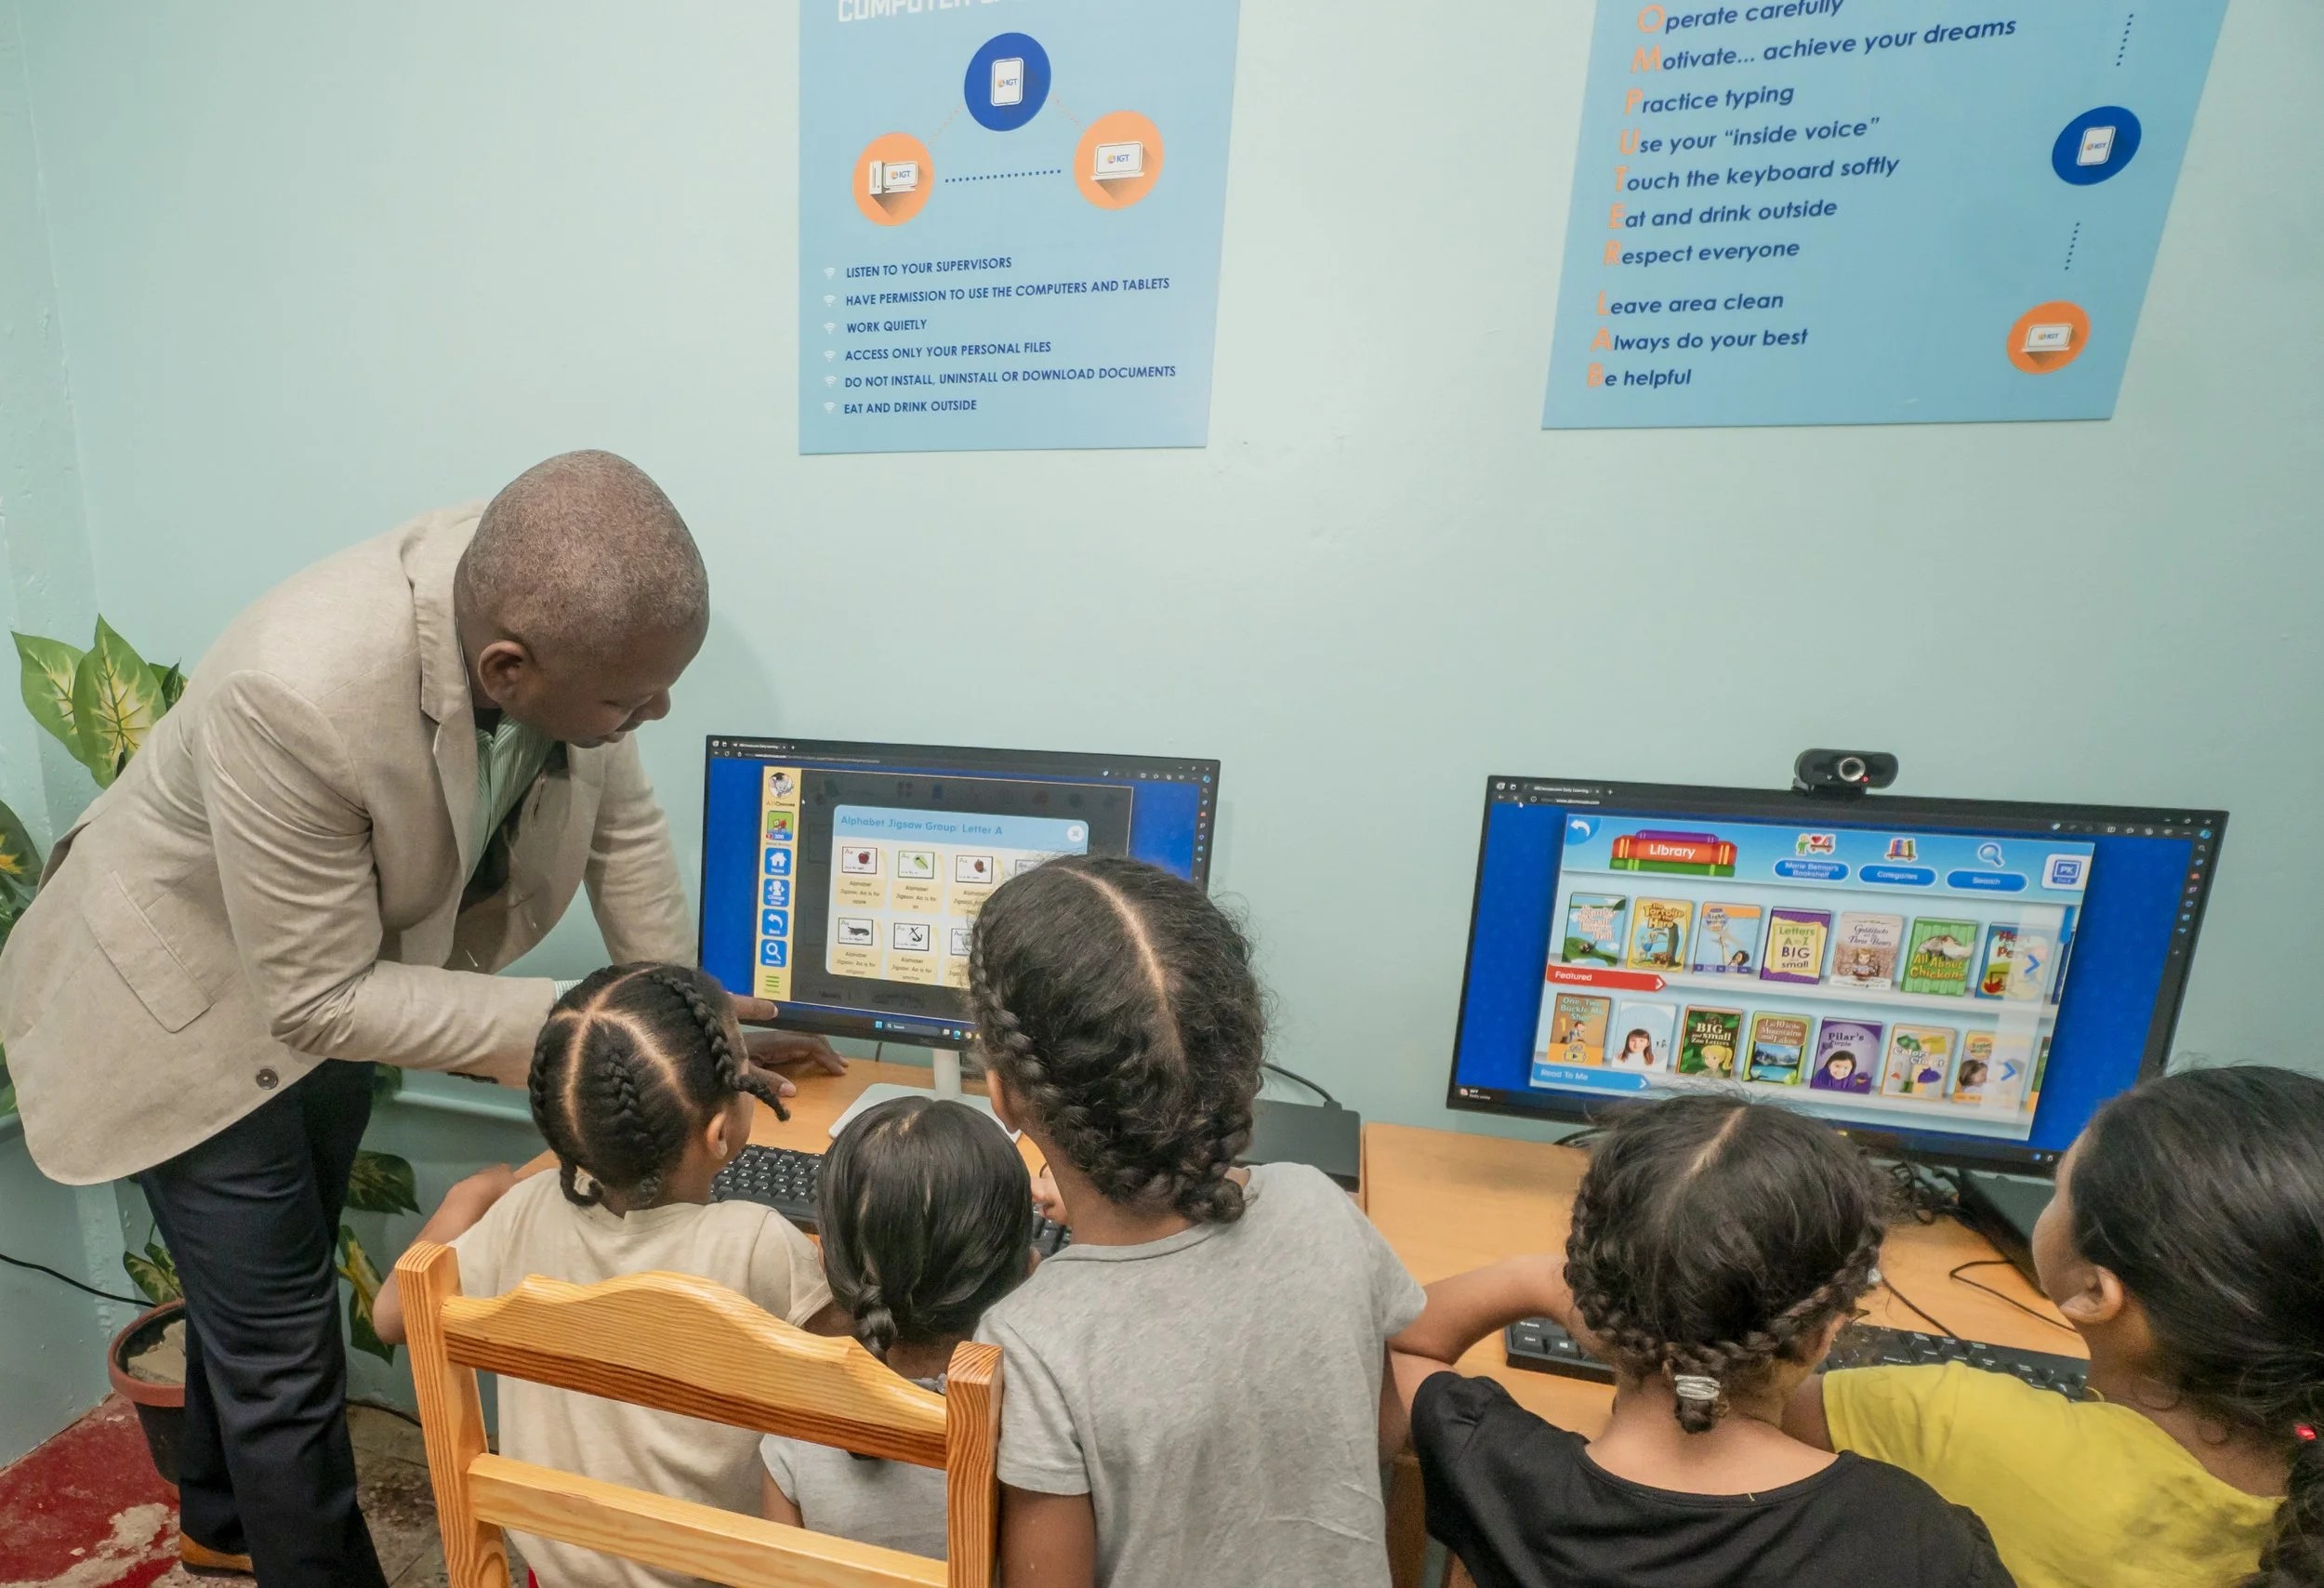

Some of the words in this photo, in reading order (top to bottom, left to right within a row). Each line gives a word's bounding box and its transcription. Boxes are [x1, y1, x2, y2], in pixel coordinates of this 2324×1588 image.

[1637, 4, 1737, 34] Operate
[1746, 0, 1843, 21] carefully
[1631, 45, 1754, 73] Motivate...
[1763, 38, 1856, 60] achieve
[1864, 31, 1917, 55] your
[1923, 20, 2016, 44] dreams
[1005, 78, 1018, 86] IGT
[1624, 88, 1718, 115] Practice
[1725, 86, 1794, 111] typing
[1620, 127, 1662, 155] Use
[1670, 135, 1717, 155] your
[1724, 126, 1797, 146] “inside
[1805, 117, 1880, 139] voice”
[1116, 153, 1129, 163] IGT
[899, 170, 911, 179] IGT
[1615, 165, 1680, 192] Touch
[1686, 170, 1720, 187] the
[1726, 160, 1835, 187] keyboard
[1841, 156, 1900, 178] softly
[1608, 203, 1645, 229] Eat
[1652, 208, 1693, 226] and
[1699, 205, 1751, 223] drink
[1759, 199, 1837, 220] outside
[1604, 240, 1693, 267] Respect
[1698, 243, 1800, 262] everyone
[847, 266, 879, 278] LISTEN
[883, 265, 897, 275] TO
[902, 262, 932, 274] YOUR
[936, 258, 1011, 271] SUPERVISORS
[847, 295, 876, 306] HAVE
[879, 290, 946, 304] PERMISSION
[950, 289, 964, 299] TO
[969, 288, 988, 298] USE
[992, 286, 1011, 298] THE
[1016, 283, 1087, 296] COMPUTERS
[1091, 281, 1118, 292] AND
[1123, 278, 1169, 290] TABLETS
[1597, 289, 1662, 316] Leave
[1669, 298, 1717, 312] area
[1723, 294, 1784, 310] clean
[847, 322, 879, 333] WORK
[884, 320, 927, 331] QUIETLY
[1590, 326, 1670, 353] Always
[1677, 333, 1703, 349] do
[1710, 334, 1757, 351] your
[1763, 328, 1808, 346] best
[845, 349, 889, 361] ACCESS
[892, 348, 922, 358] ONLY
[926, 346, 957, 357] YOUR
[961, 343, 1020, 355] PERSONAL
[1024, 342, 1051, 352] FILES
[845, 377, 862, 388] DO
[865, 377, 888, 387] NOT
[891, 375, 935, 386] INSTALL,
[940, 372, 997, 384] UNINSTALL
[1002, 371, 1018, 381] OR
[1023, 369, 1094, 381] DOWNLOAD
[1099, 365, 1176, 378] DOCUMENTS
[1587, 362, 1618, 388] Be
[1624, 369, 1691, 389] helpful
[844, 404, 863, 414] EAT
[866, 403, 891, 414] AND
[894, 402, 927, 413] DRINK
[931, 400, 977, 411] OUTSIDE
[840, 815, 884, 827] Alphabet
[888, 819, 922, 829] Jigsaw
[925, 822, 958, 833] Group:
[962, 824, 992, 835] Letter
[996, 826, 1003, 835] A
[1649, 844, 1696, 860] Library
[1792, 869, 1829, 878] Bookshelf
[1877, 870, 1918, 880] Categories
[2060, 866, 2074, 874] PK
[1644, 904, 1684, 918] Tortoise
[1647, 918, 1674, 929] Hare
[1779, 927, 1815, 936] Letters
[1803, 937, 1809, 946] Z
[1781, 946, 1811, 959] BIG
[1913, 953, 1928, 963] All
[1930, 957, 1963, 969] About
[1554, 971, 1592, 982] Featured
[1697, 1022, 1723, 1034] BIG
[1761, 1026, 1802, 1037] Mountains
[1702, 1032, 1731, 1041] small
[1829, 1032, 1865, 1042] Pilar's
[1540, 1068, 1562, 1079] Read
[1565, 1071, 1574, 1079] To
[1575, 1072, 1589, 1080] Me
